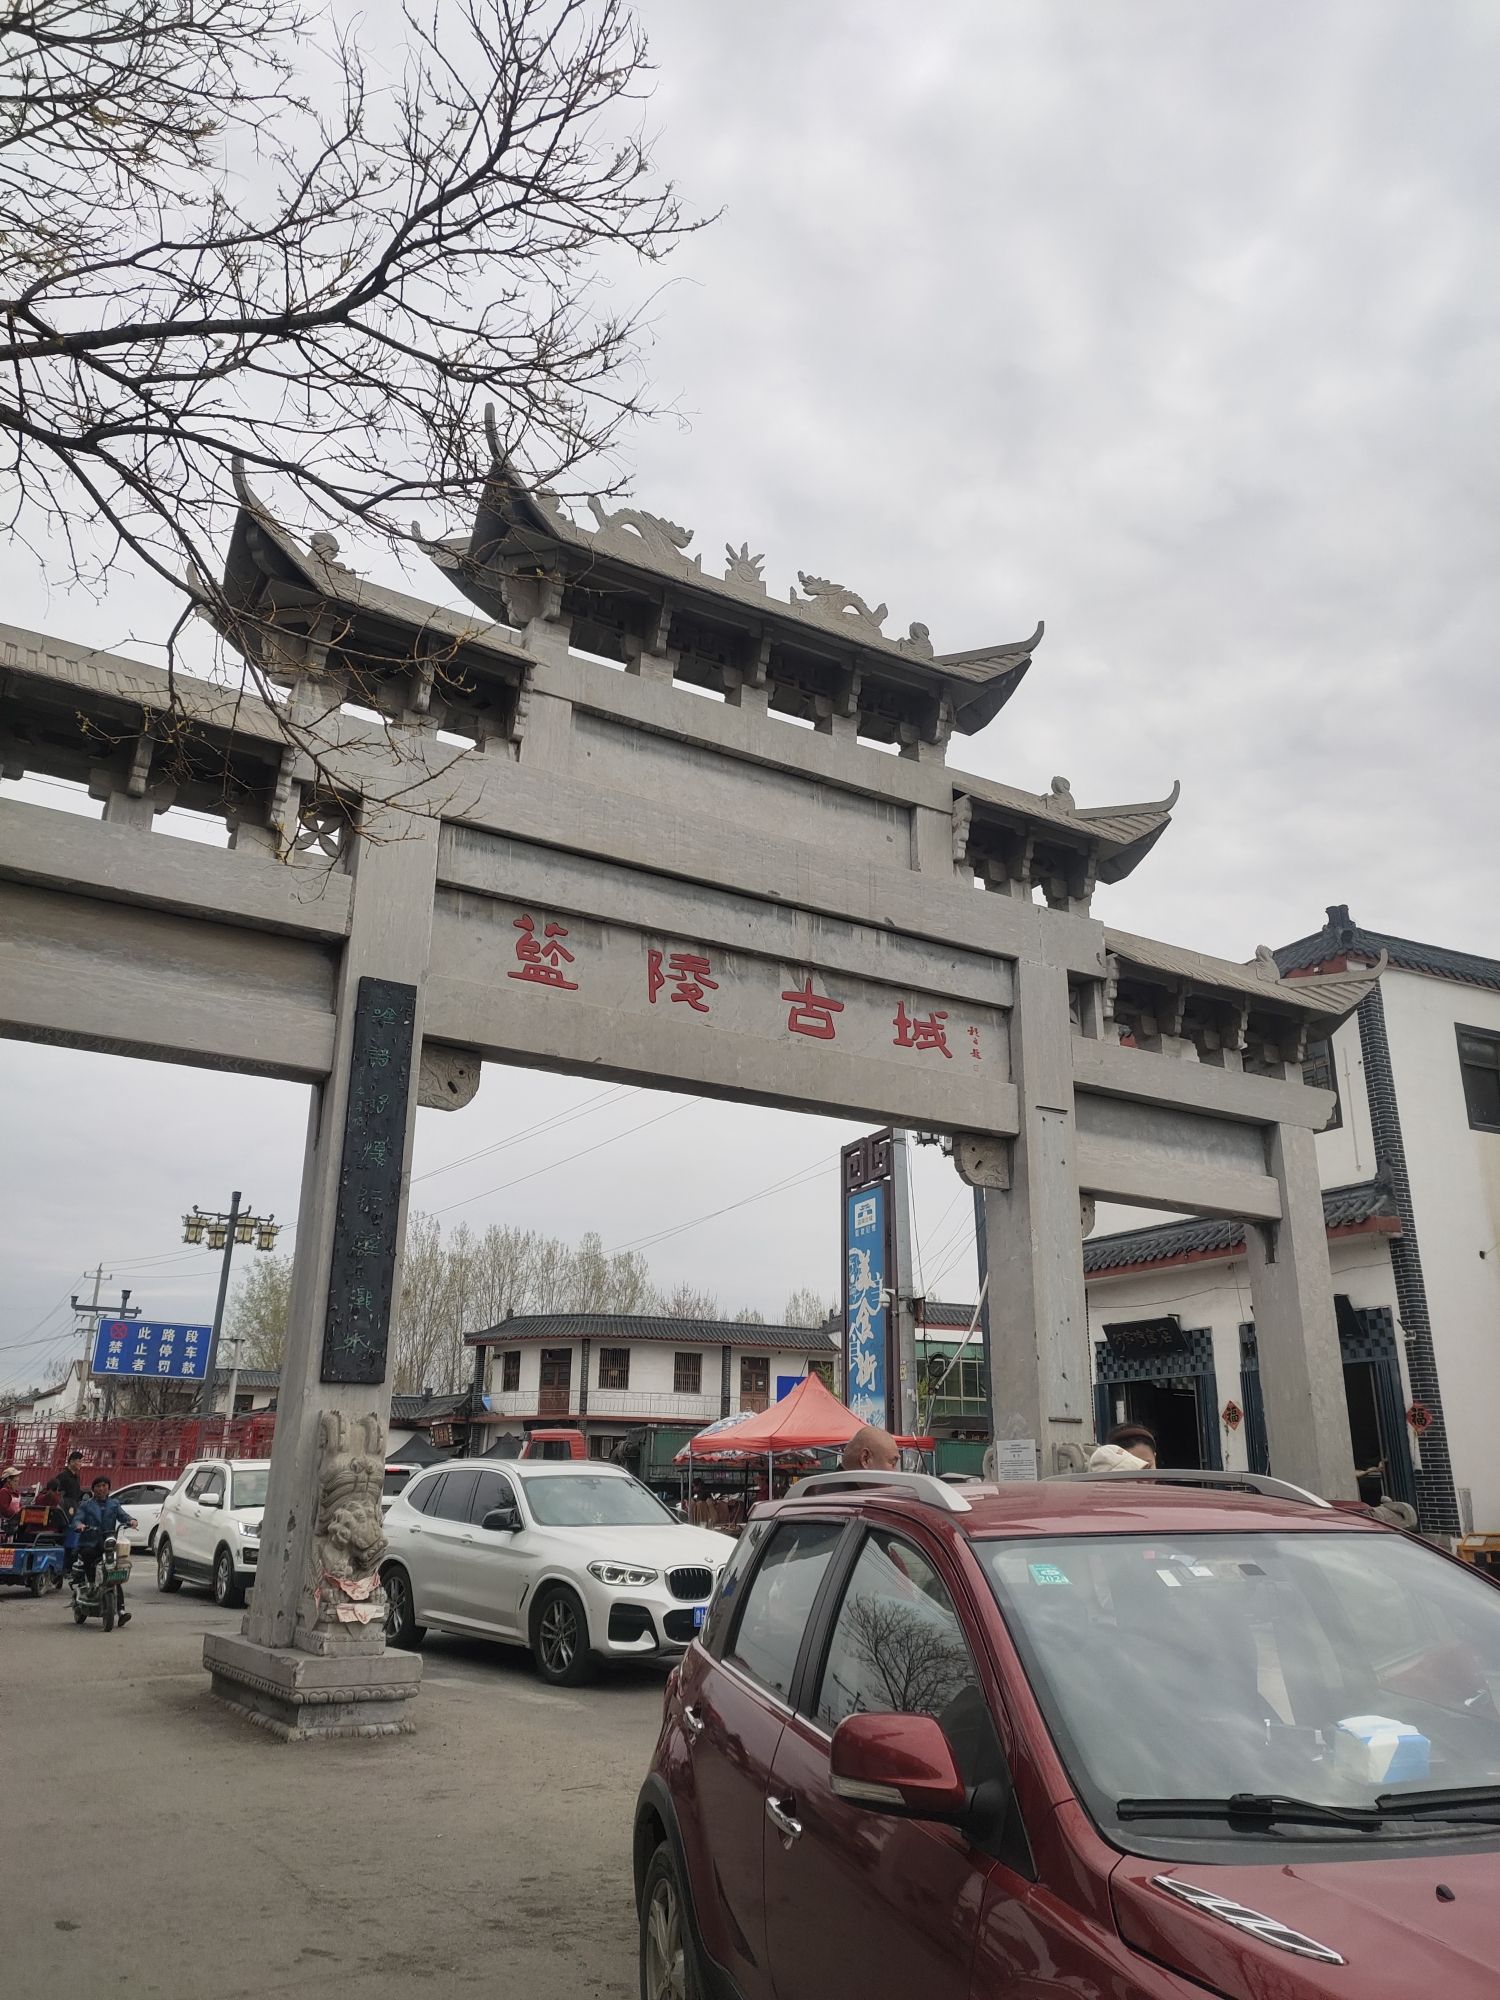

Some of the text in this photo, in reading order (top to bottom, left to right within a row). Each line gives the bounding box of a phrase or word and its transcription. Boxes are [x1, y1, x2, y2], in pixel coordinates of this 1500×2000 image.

[138, 1326, 199, 1343] 此路段
[108, 1340, 198, 1359] 禁止停车
[105, 1356, 196, 1375] 违者罚款
[1411, 1406, 1427, 1426] 福
